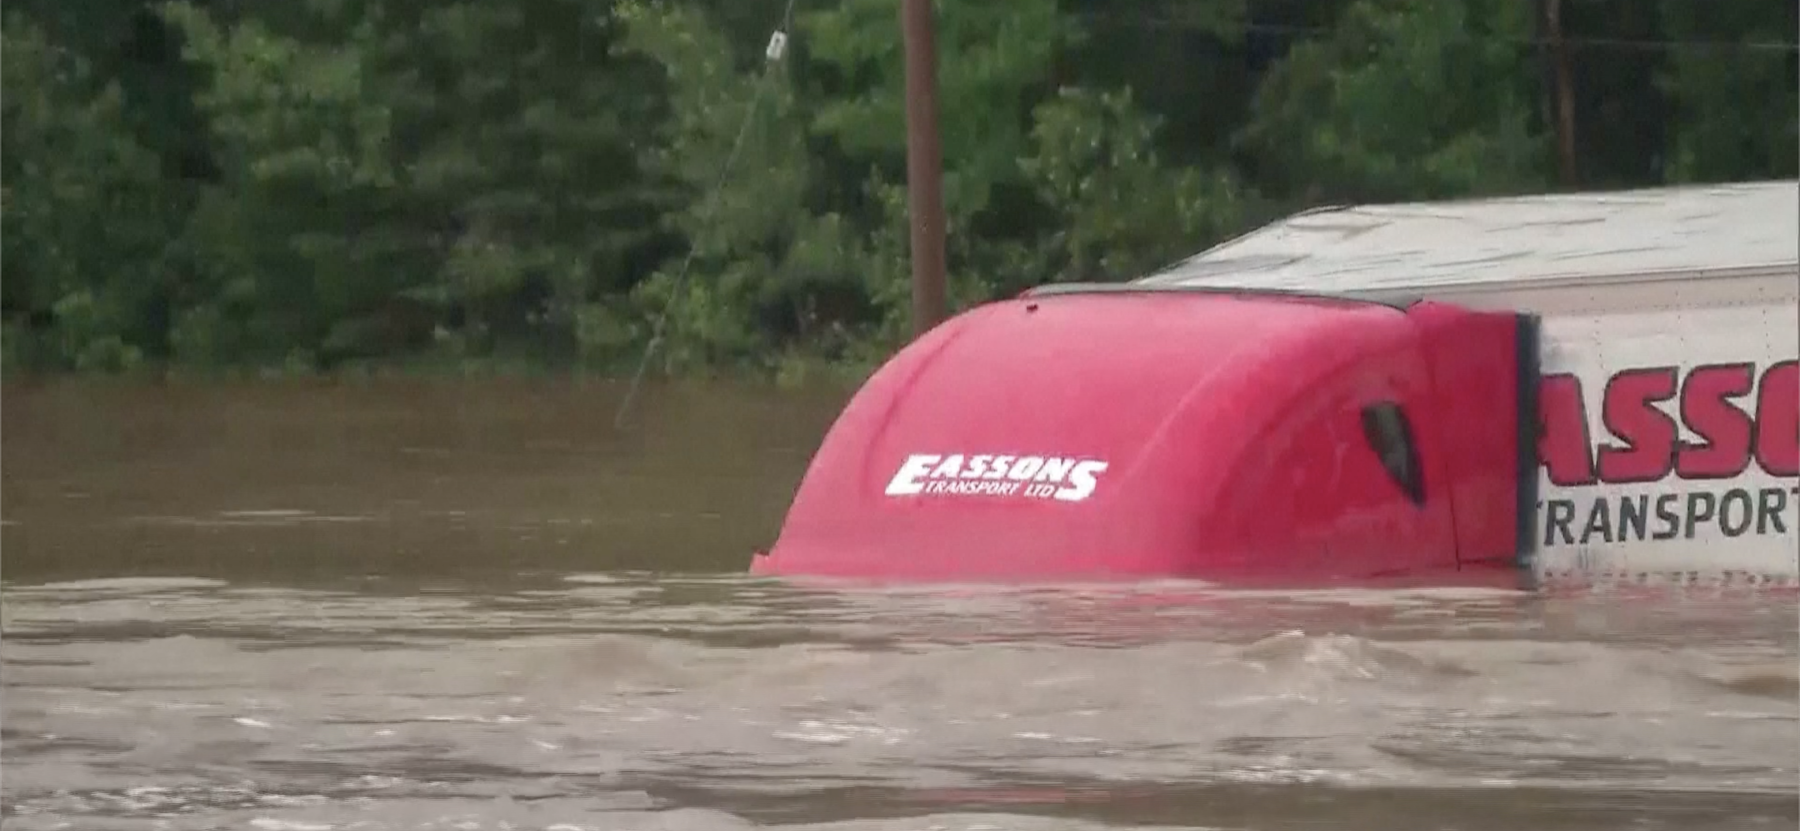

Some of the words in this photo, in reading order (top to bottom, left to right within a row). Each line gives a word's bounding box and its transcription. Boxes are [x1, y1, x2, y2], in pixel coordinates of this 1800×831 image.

[885, 454, 1108, 501] EASSONS
[925, 479, 1020, 495] TRANSPORT
[1024, 483, 1055, 498] LTD
[1537, 487, 1799, 546] RANSPOR
